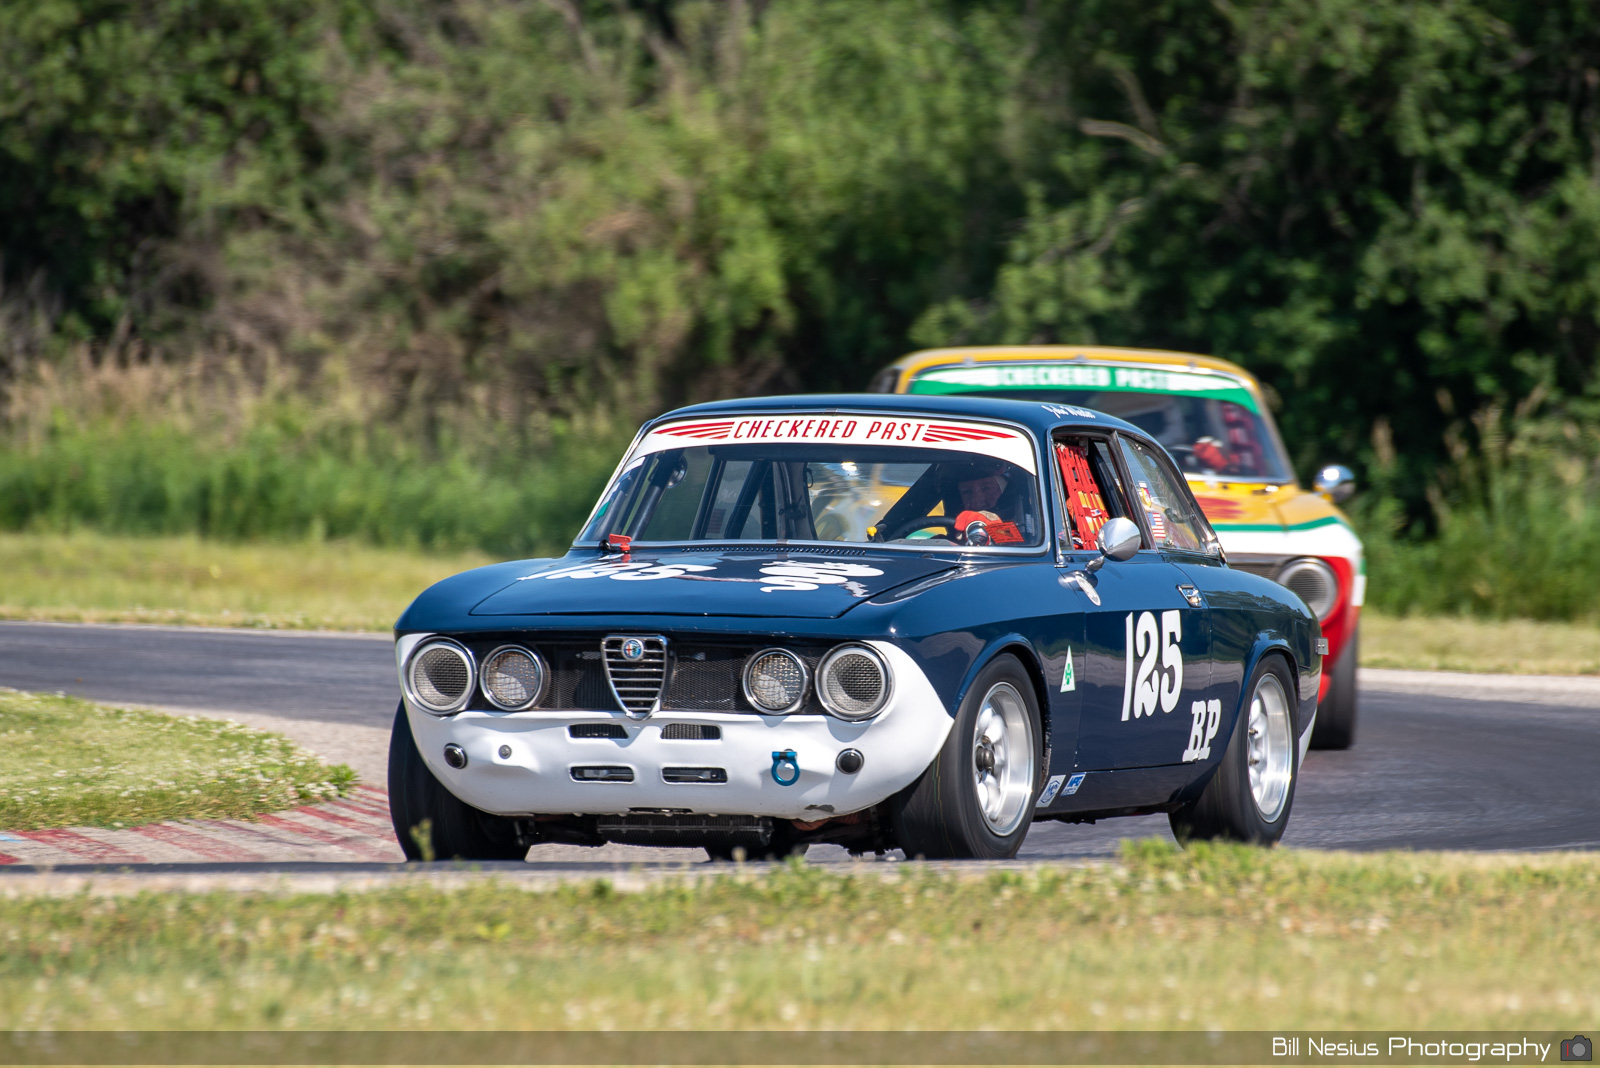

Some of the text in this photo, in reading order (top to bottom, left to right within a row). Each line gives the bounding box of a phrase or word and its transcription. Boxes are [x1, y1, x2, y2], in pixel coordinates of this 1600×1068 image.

[733, 419, 926, 442] CHECKERED PAST
[516, 562, 718, 581] 125
[1121, 609, 1184, 722] 125
[1182, 698, 1222, 763] BP
